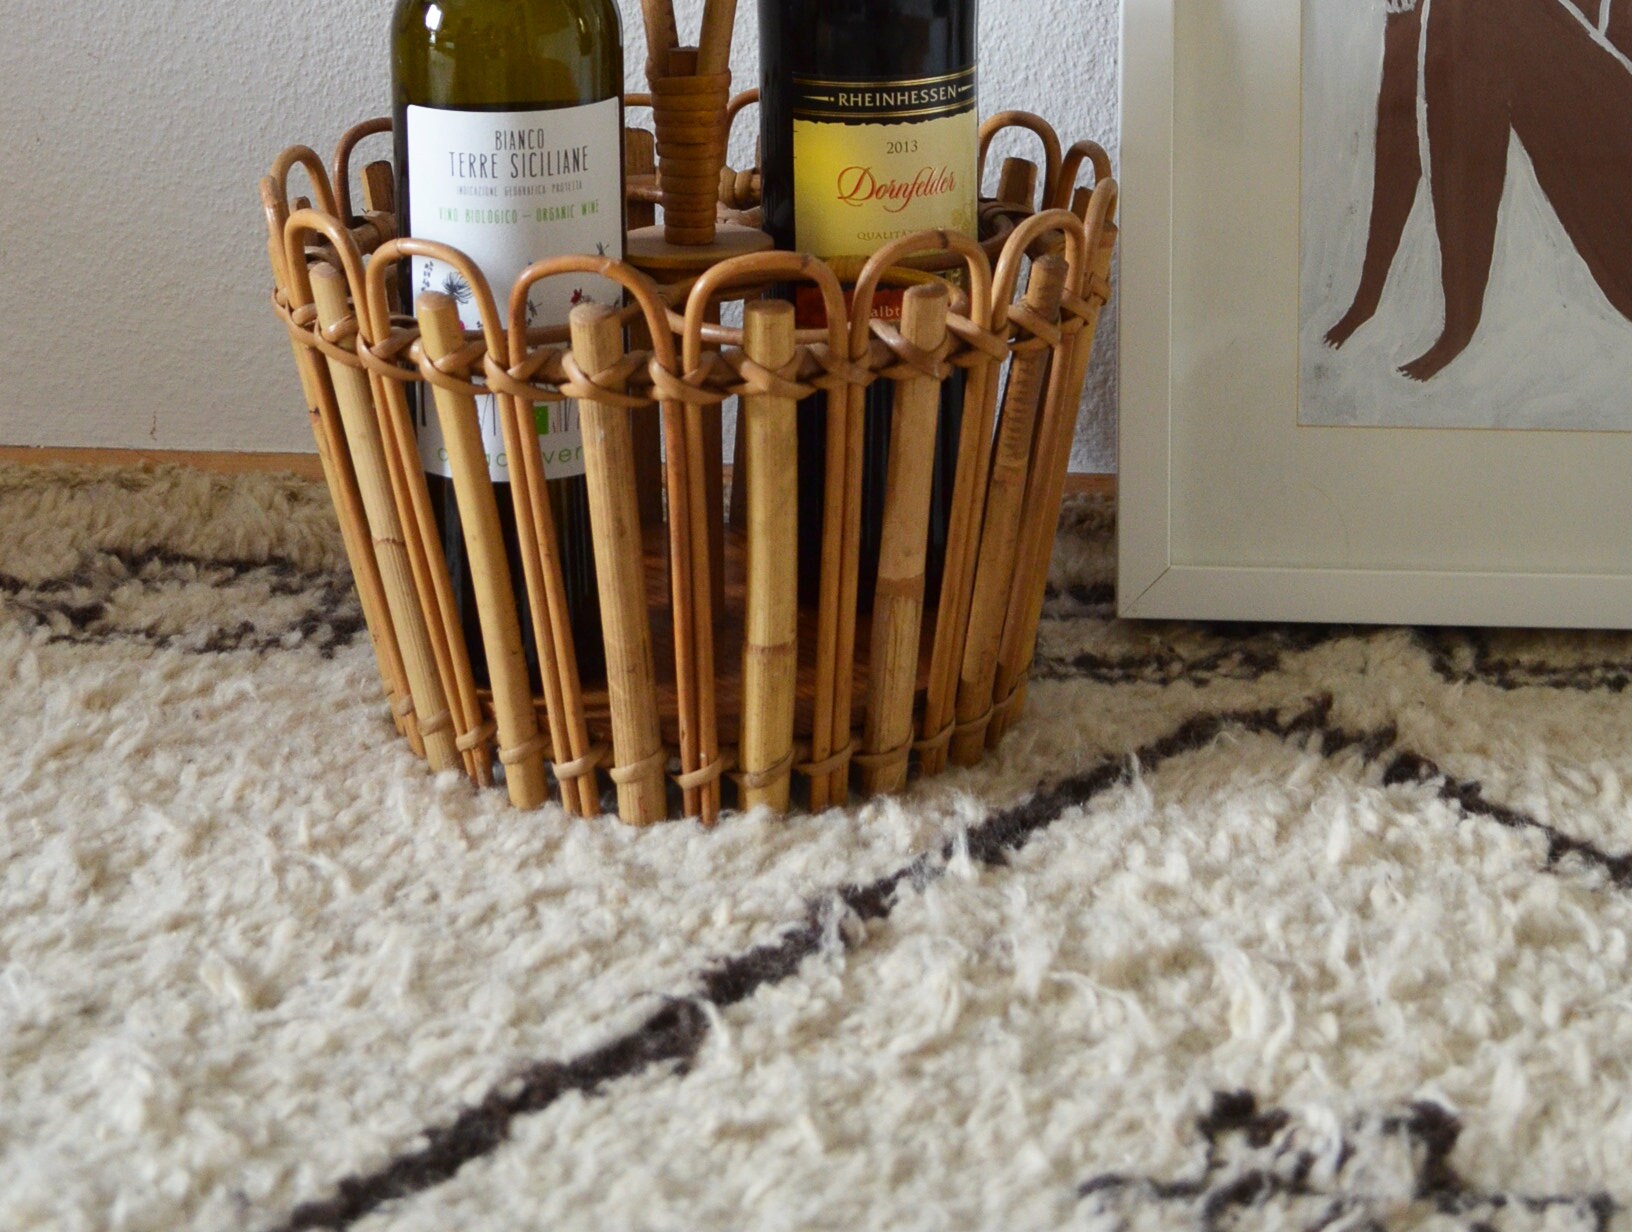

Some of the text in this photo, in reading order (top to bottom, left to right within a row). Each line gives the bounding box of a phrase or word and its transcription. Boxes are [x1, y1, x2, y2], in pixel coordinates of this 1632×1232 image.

[838, 85, 957, 106] RHEINHESSEN
[495, 128, 545, 151] BIANCO
[886, 140, 918, 154] 2013
[449, 145, 589, 179] TERRE SICILIANE
[837, 166, 955, 213] Dornfelder
[439, 207, 458, 222] VINO
[465, 209, 518, 224] BIOLOGICO
[536, 203, 575, 223] ORGANIC
[581, 199, 599, 216] WINE
